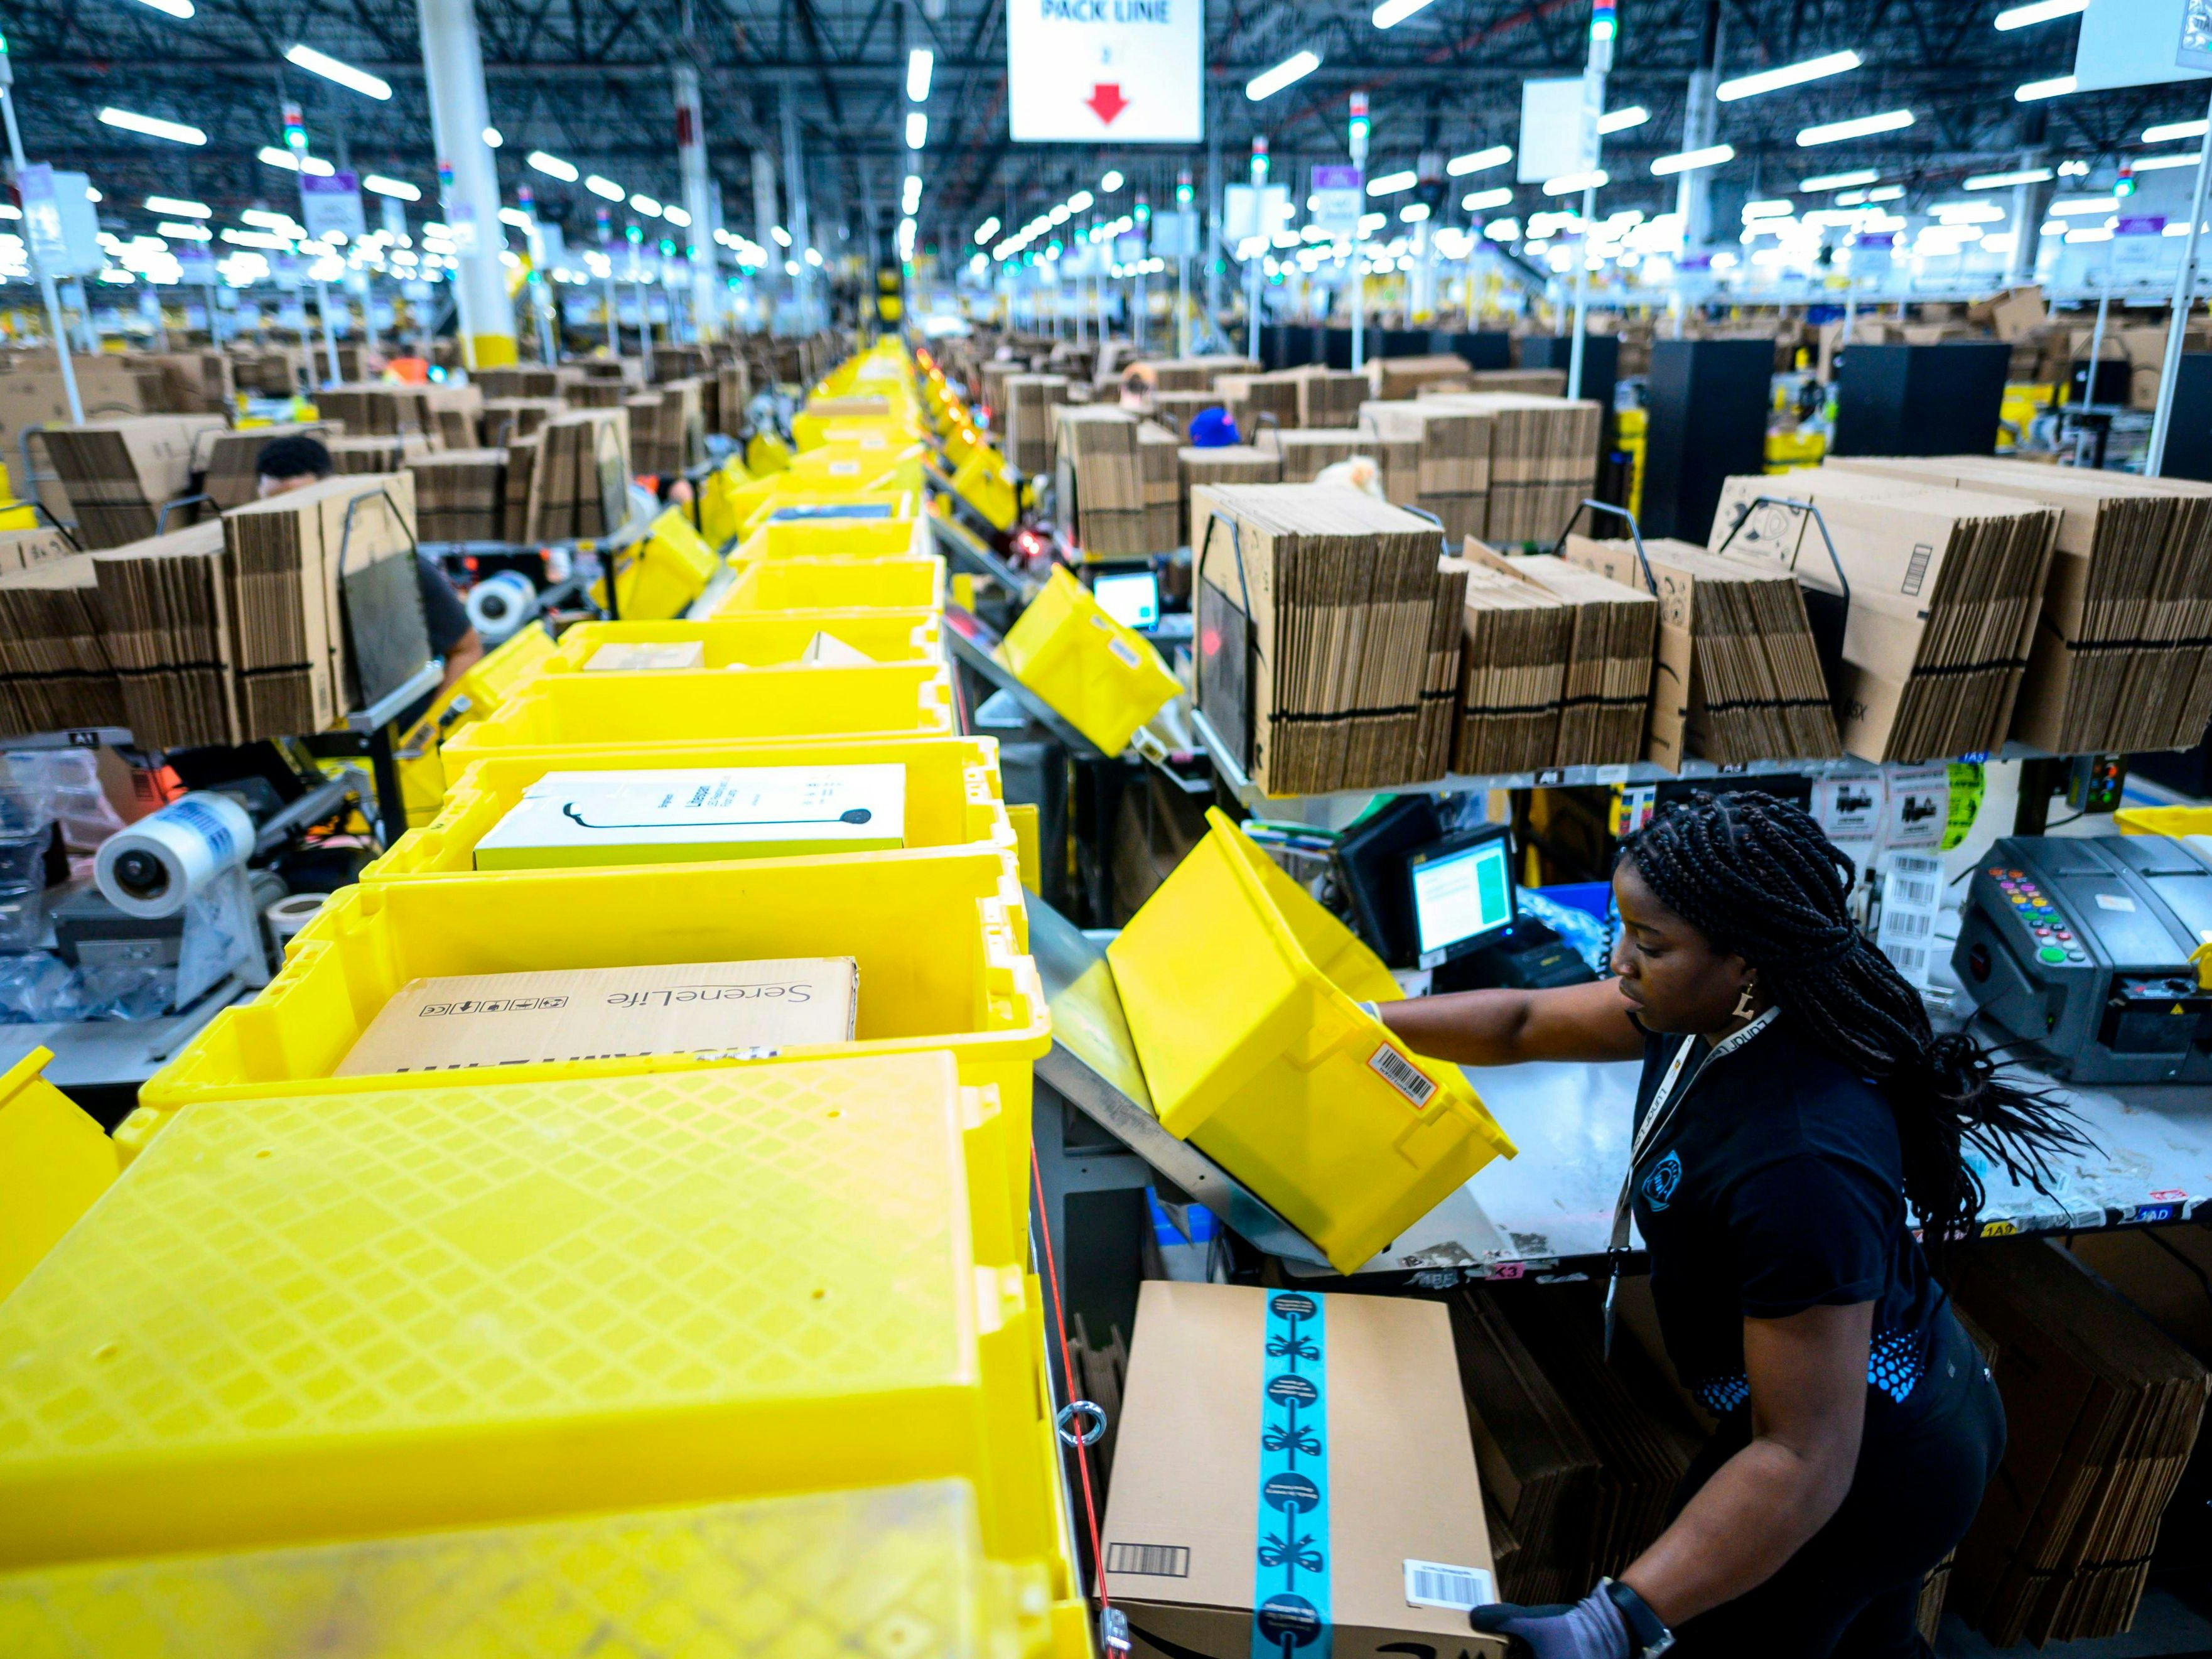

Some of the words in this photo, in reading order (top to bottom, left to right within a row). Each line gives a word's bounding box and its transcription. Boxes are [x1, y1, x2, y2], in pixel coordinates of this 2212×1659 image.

[1041, 0, 1107, 21] PACK
[1114, 0, 1170, 23] LINE
[607, 985, 812, 1008] SereneLife
[1730, 1020, 1768, 1049] Lunar
[1645, 1088, 1668, 1127] Lunar
[1268, 1484, 1315, 1493] department
